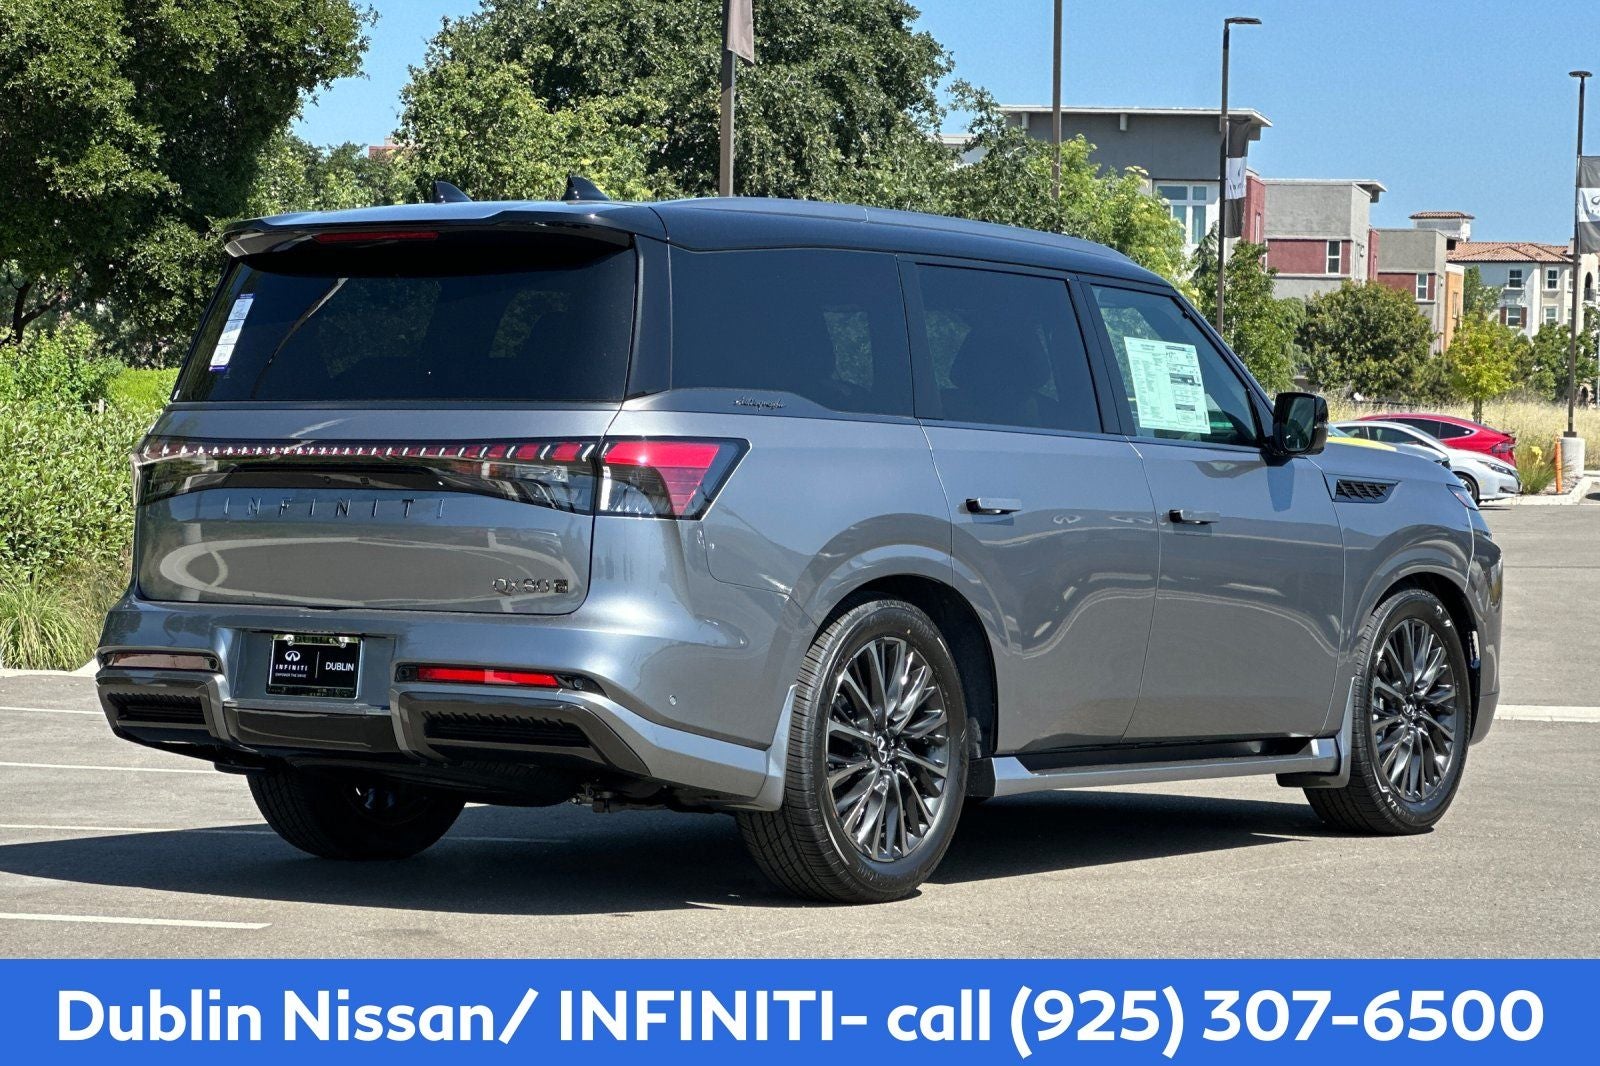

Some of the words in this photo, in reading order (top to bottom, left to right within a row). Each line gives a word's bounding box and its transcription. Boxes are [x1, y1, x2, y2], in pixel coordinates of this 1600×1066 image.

[224, 497, 446, 518] INFINITI
[492, 578, 550, 596] QX80
[325, 662, 354, 671] DUBLIN
